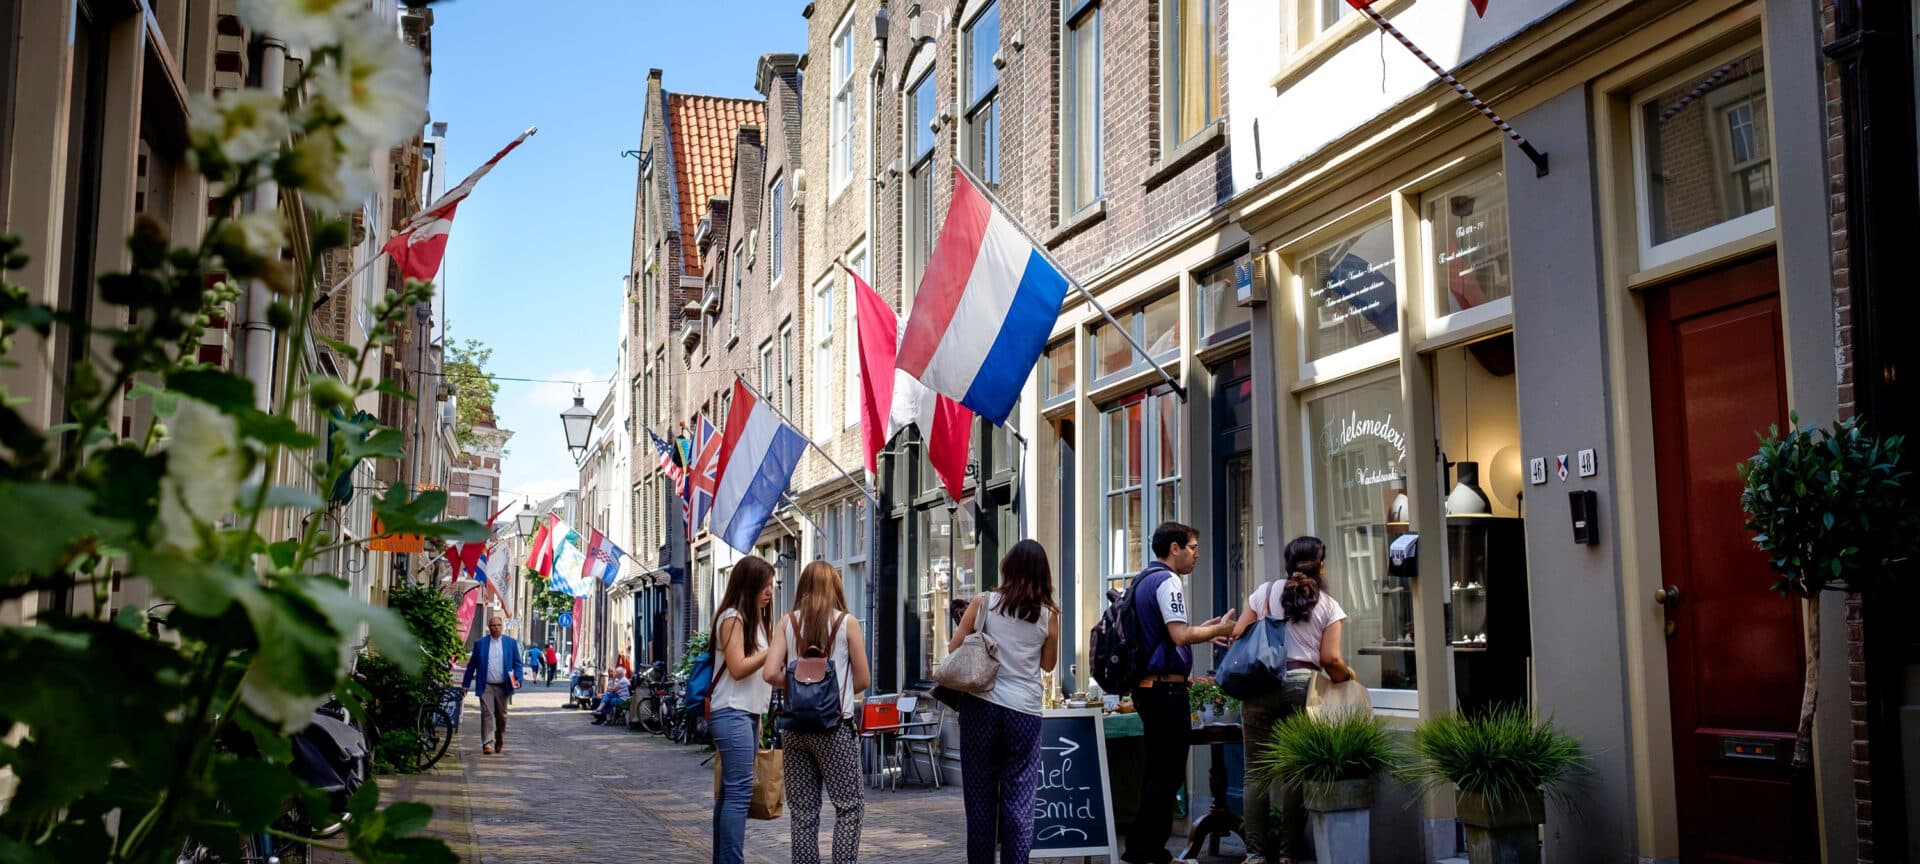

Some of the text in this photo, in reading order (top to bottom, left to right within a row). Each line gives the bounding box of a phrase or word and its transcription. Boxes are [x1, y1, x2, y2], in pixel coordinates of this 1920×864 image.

[1582, 452, 1592, 473] 48
[1533, 461, 1543, 481] 46
[1170, 591, 1183, 603] 18
[1170, 602, 1185, 614] 90
